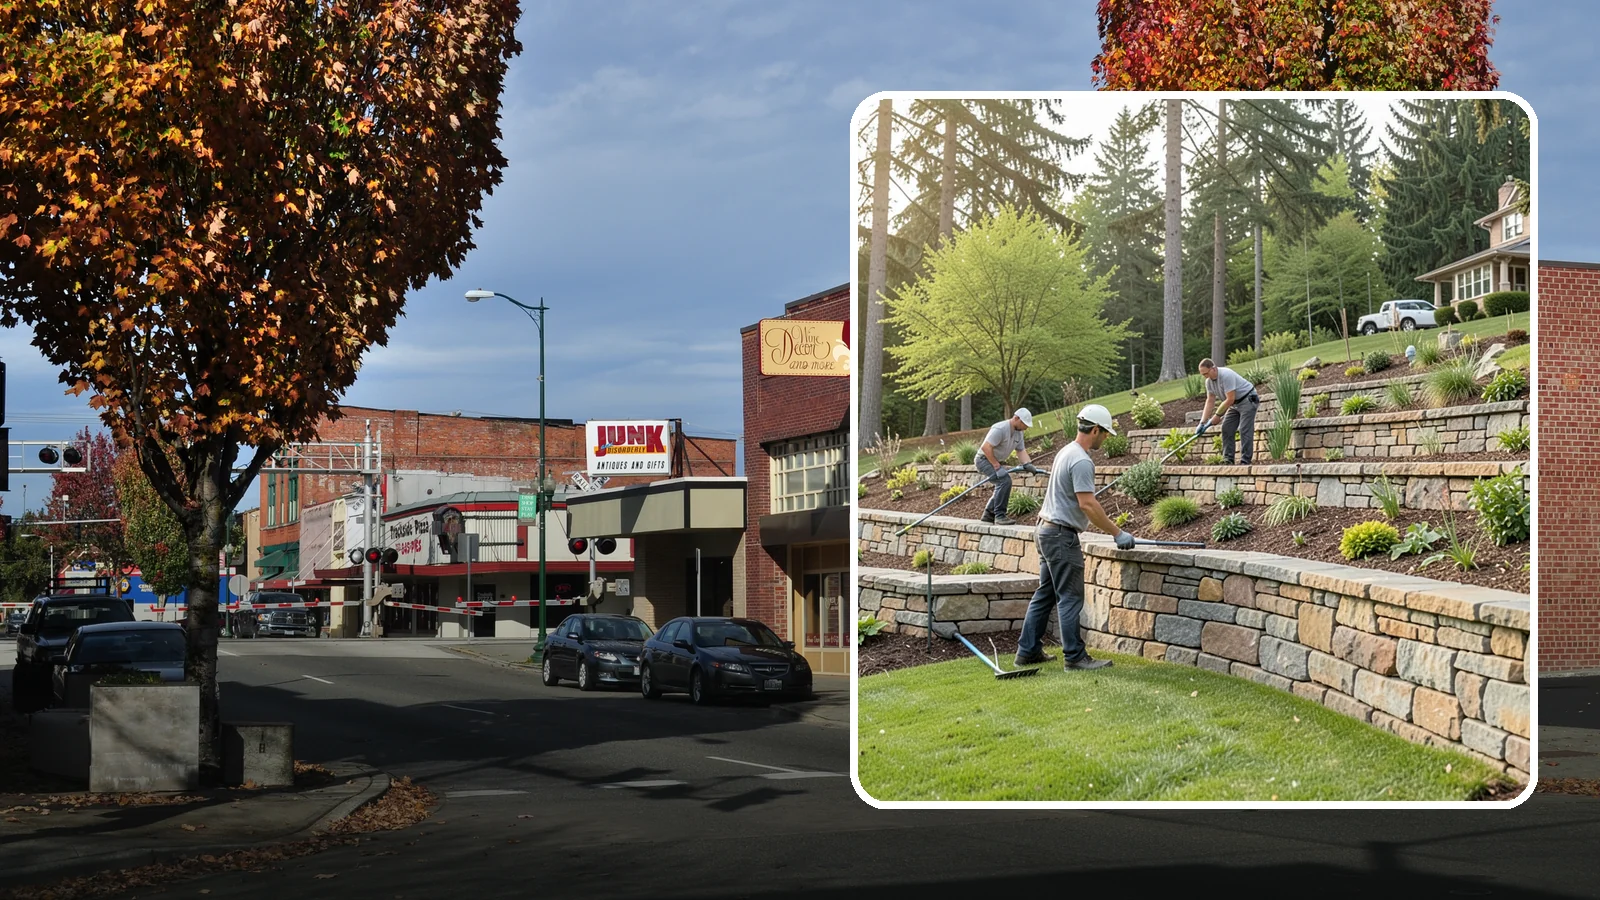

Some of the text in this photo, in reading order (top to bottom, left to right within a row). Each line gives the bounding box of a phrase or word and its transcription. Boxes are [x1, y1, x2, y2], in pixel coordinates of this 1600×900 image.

[595, 425, 664, 457] JUNK
[607, 446, 646, 454] DISORDERLY
[596, 461, 665, 470] ANTIQUES AND GIFTS
[390, 519, 429, 539] Trackside Pizza
